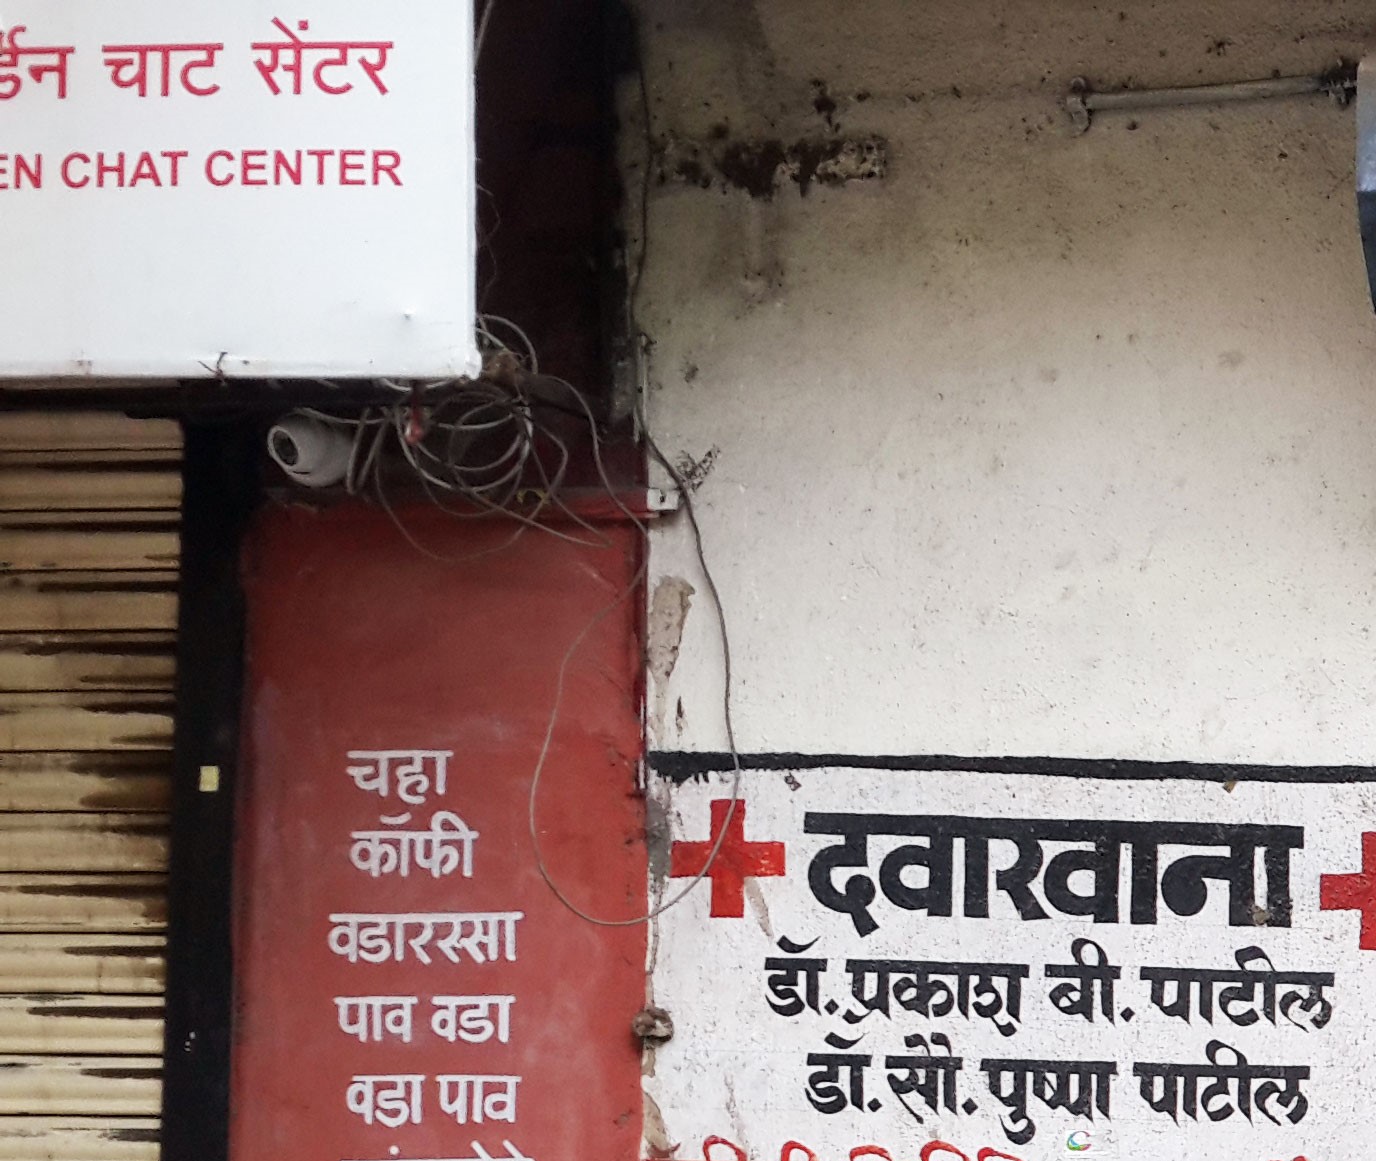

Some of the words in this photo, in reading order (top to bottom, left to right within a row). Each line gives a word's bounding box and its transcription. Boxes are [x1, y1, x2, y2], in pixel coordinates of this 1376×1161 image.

[103, 44, 223, 96] चाट
[252, 16, 392, 94] सेंटर
[62, 152, 187, 188] CHAT
[206, 151, 402, 186] CENTER
[347, 750, 453, 804] चहा
[351, 811, 479, 878] कॉफी
[1140, 946, 1334, 1031] पाटील
[334, 996, 418, 1043] पाव
[431, 995, 516, 1043] वडा
[346, 1075, 426, 1128] वडा
[436, 1075, 522, 1124] पाव
[1133, 1040, 1310, 1126] पाटील
